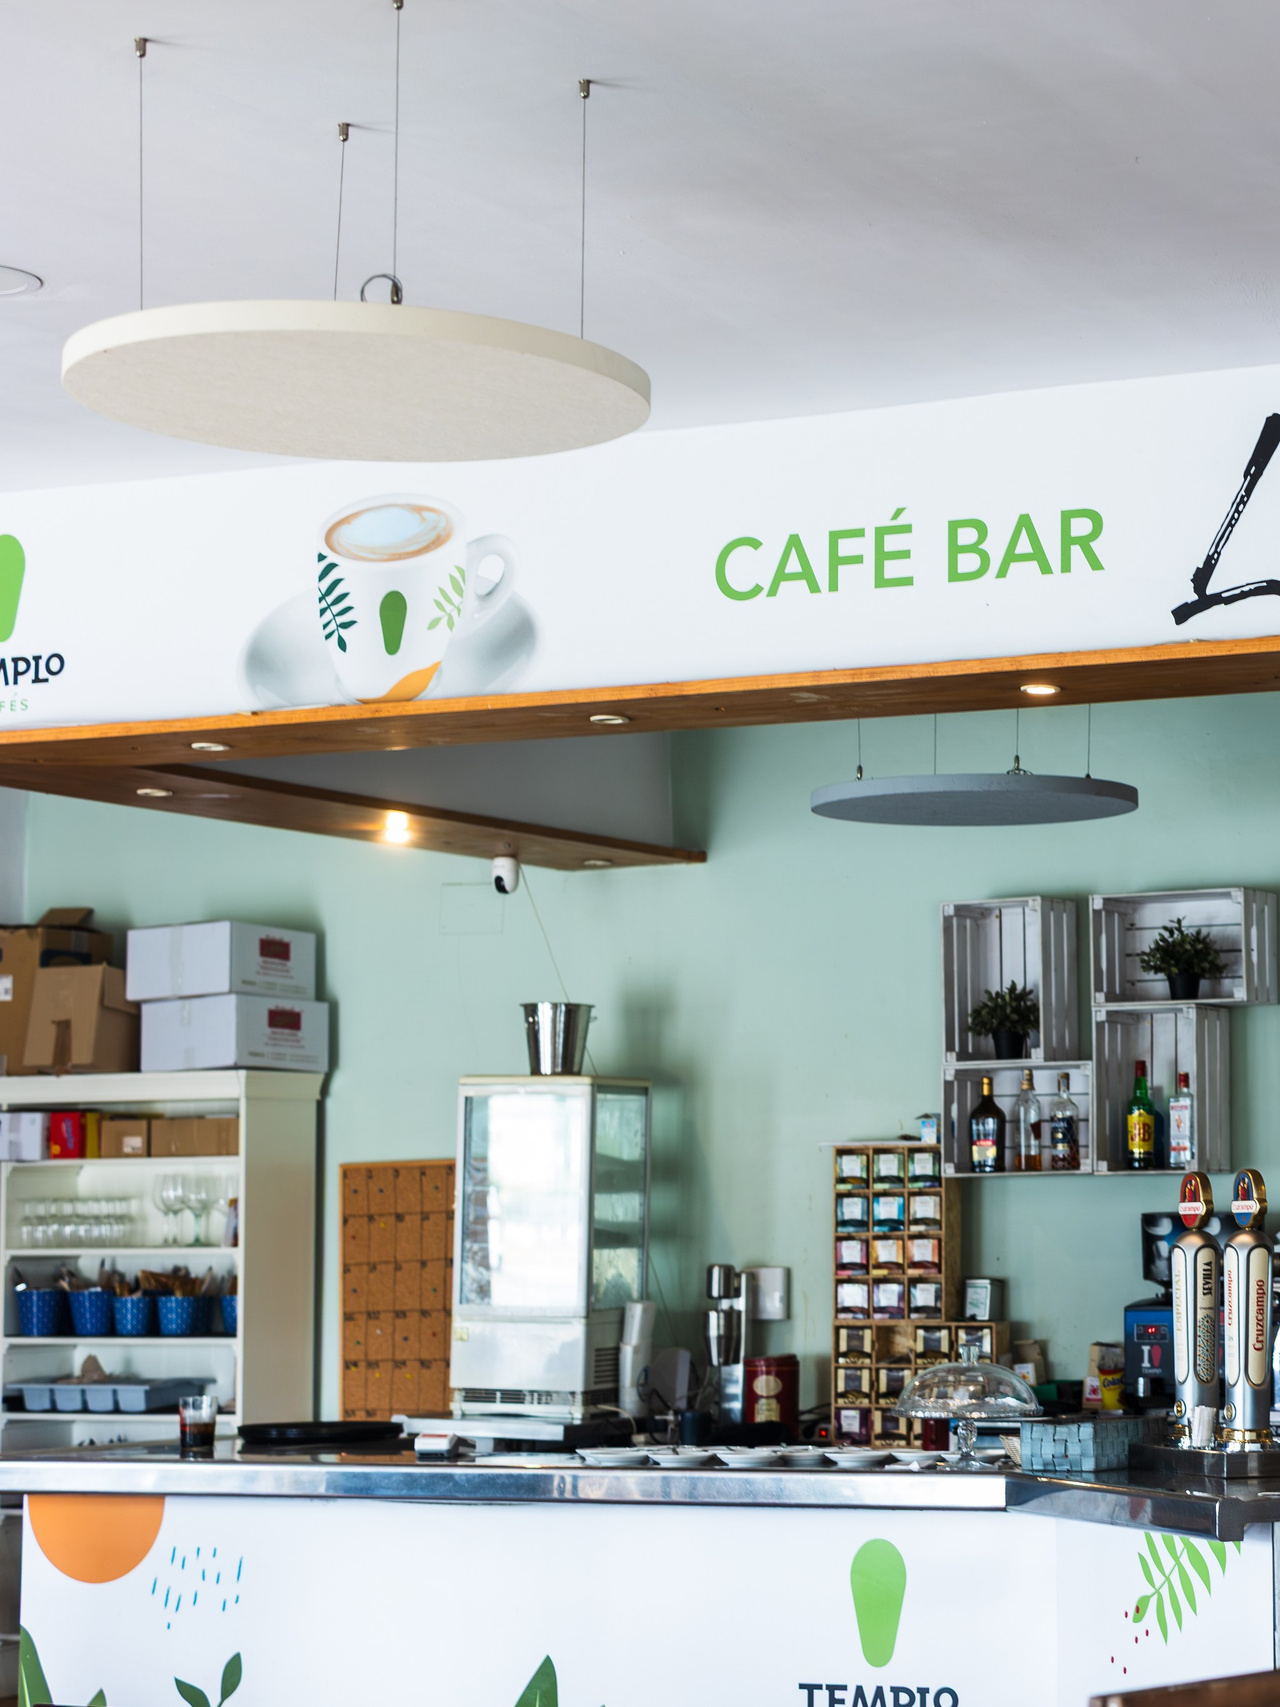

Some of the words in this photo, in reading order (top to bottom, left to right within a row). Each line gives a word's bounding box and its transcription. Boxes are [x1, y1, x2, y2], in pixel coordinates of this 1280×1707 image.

[714, 506, 914, 602] CAFÉ
[947, 508, 1105, 583] BAR
[1202, 1260, 1213, 1296] SEVILLA
[1253, 1279, 1266, 1352] Cruzcampo
